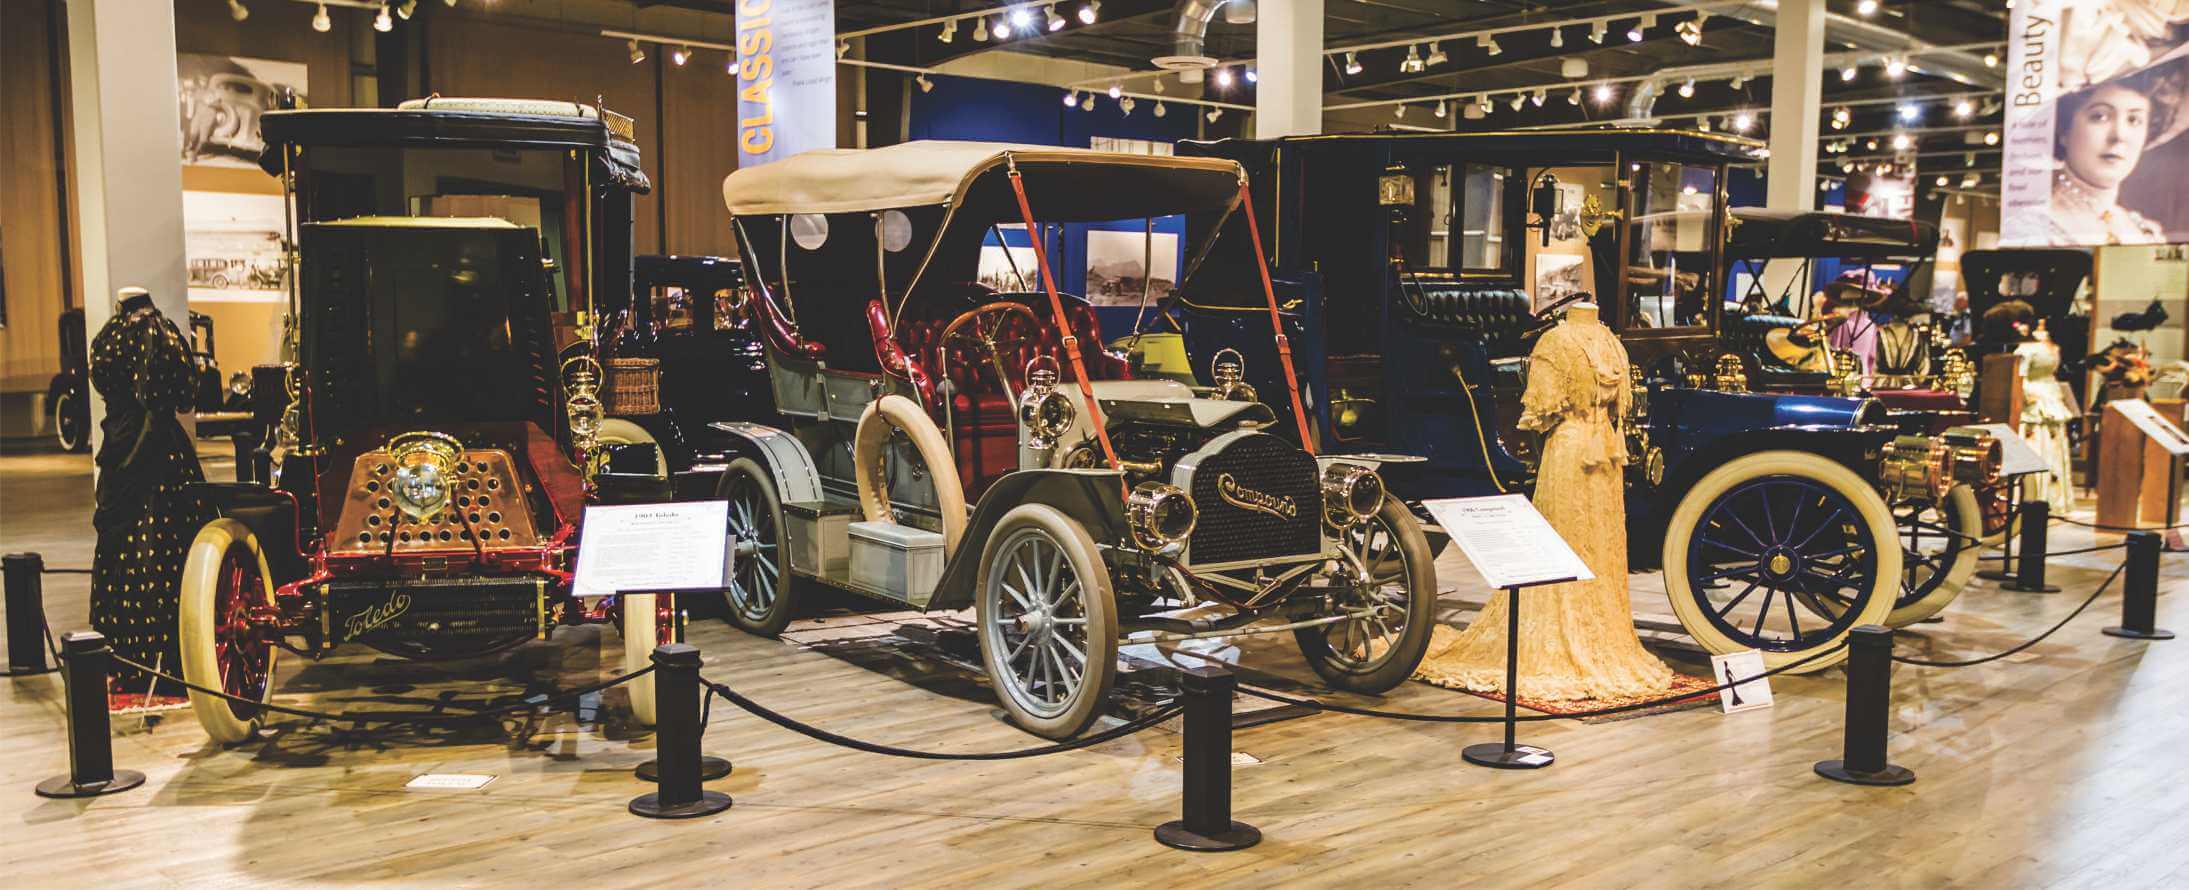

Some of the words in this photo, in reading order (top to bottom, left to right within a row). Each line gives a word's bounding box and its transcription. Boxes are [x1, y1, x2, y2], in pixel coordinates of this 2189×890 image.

[2014, 15, 2054, 107] Beauty
[1218, 472, 1297, 522] Compound
[343, 589, 411, 642] Toledo
